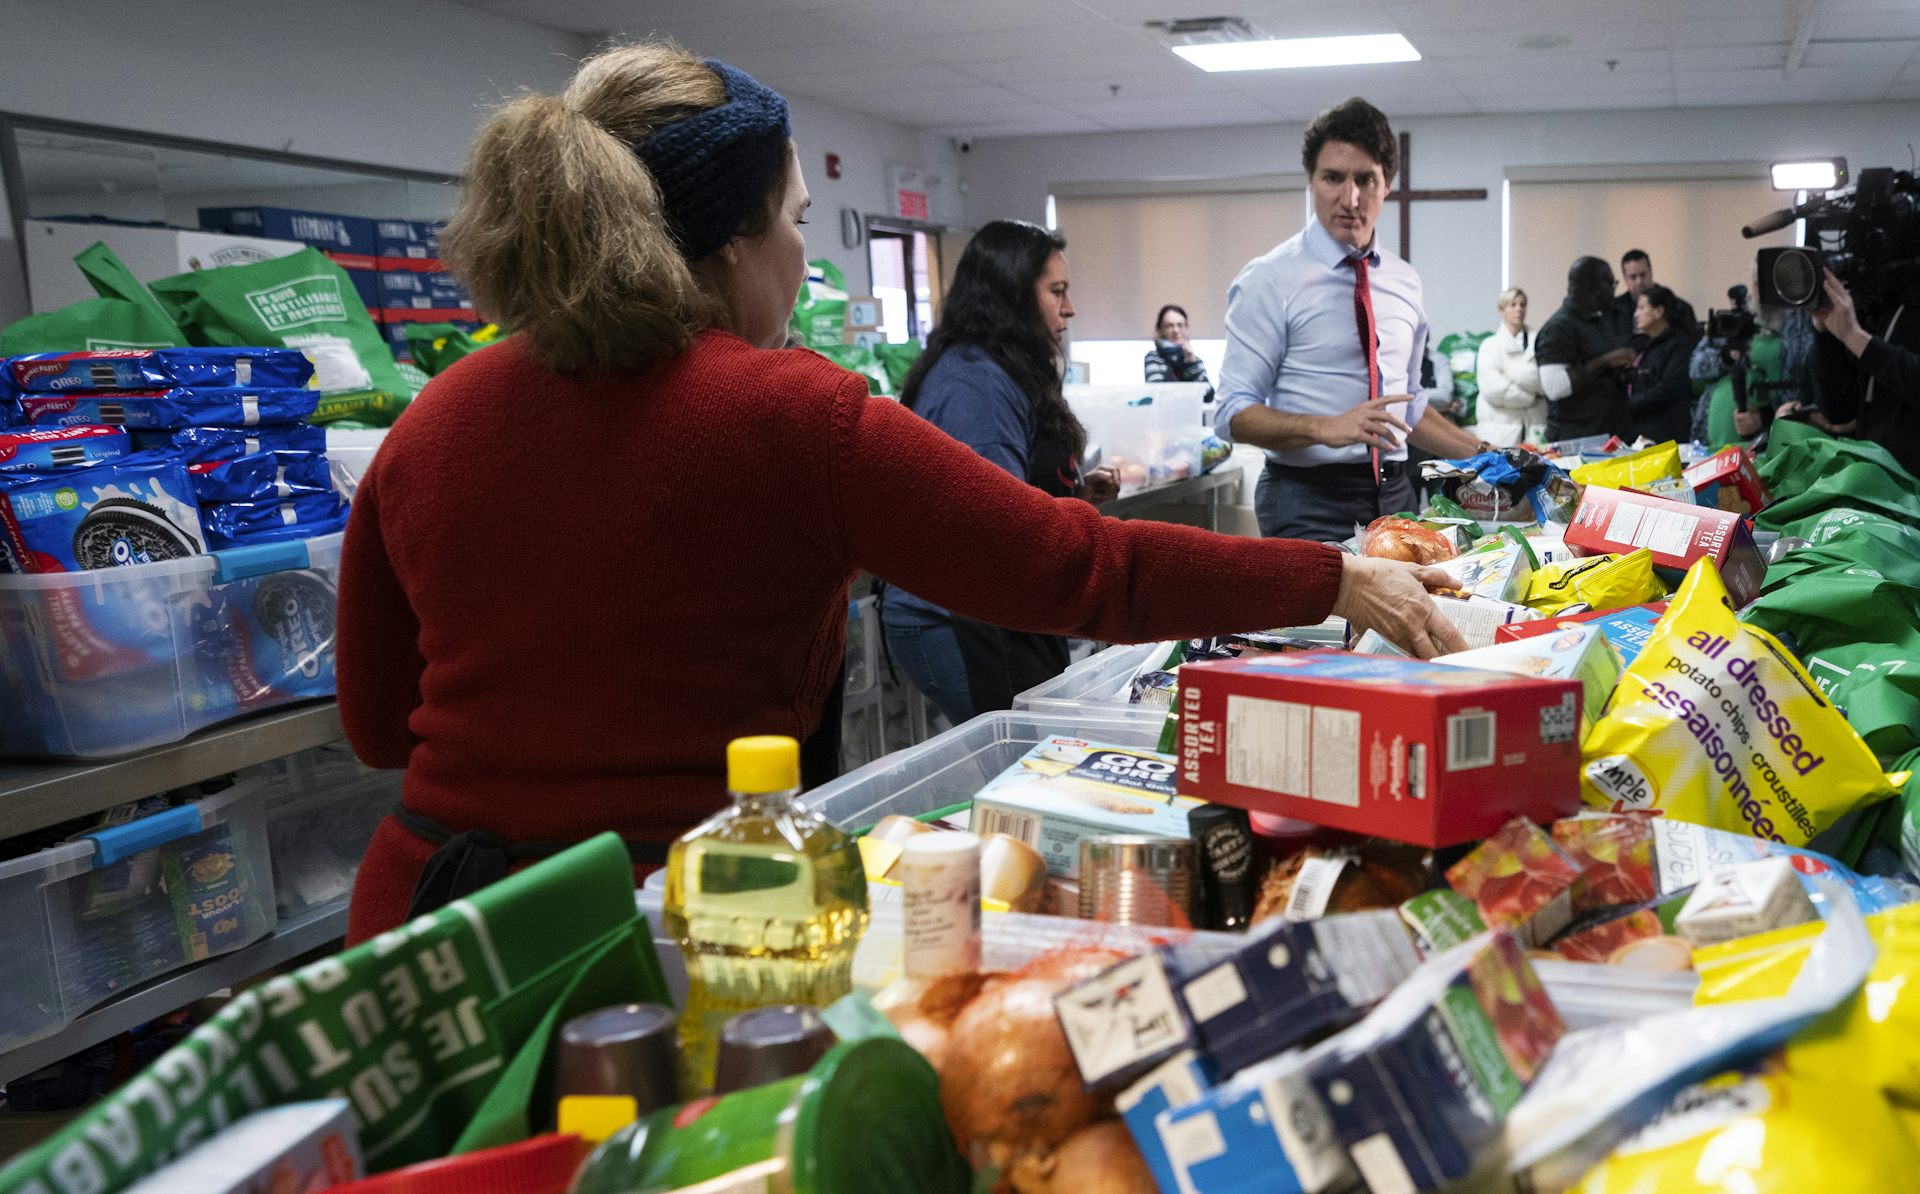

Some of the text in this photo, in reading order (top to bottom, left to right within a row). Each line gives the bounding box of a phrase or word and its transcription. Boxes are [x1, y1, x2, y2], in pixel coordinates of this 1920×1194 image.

[50, 376, 83, 391] OREO
[58, 415, 91, 426] OREO
[1698, 530, 1713, 548] TEA
[1710, 518, 1731, 564] ASSORTE
[285, 599, 320, 679] OREO
[1687, 629, 1730, 660] all
[1727, 657, 1825, 777] dressed
[1184, 687, 1201, 783] ASSORTED
[1201, 720, 1215, 754] TEA
[1665, 656, 1722, 700] potato
[1720, 698, 1751, 746] chips
[1751, 752, 1817, 839] croustilles
[1090, 761, 1170, 783] PURE
[1100, 753, 1176, 774] GO
[328, 996, 488, 1127] JE SU
